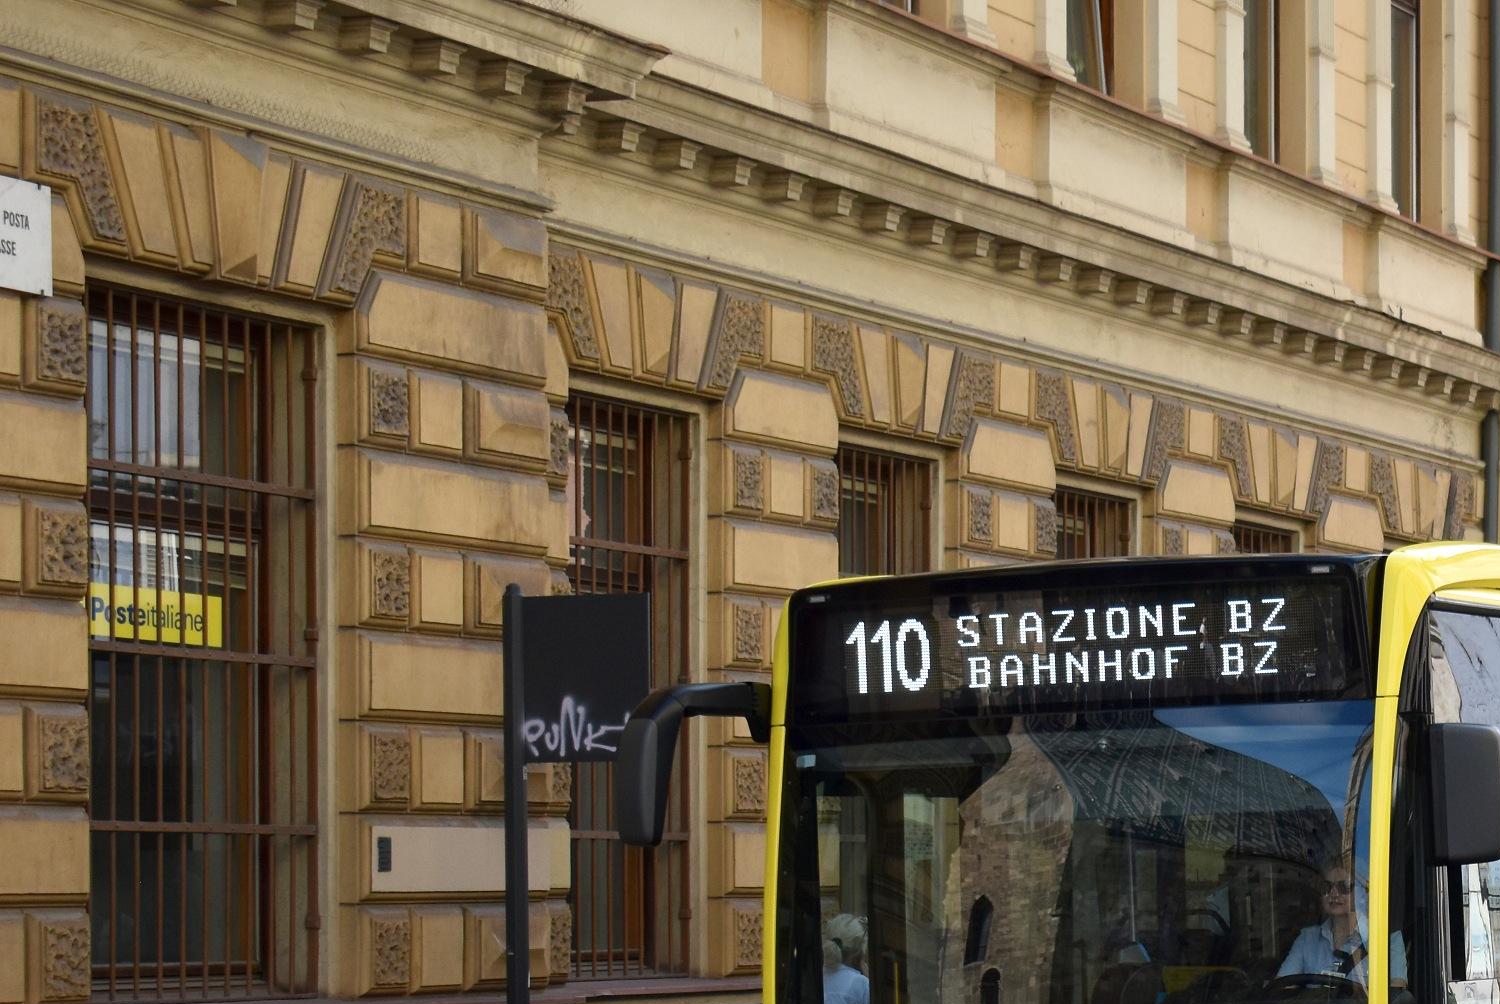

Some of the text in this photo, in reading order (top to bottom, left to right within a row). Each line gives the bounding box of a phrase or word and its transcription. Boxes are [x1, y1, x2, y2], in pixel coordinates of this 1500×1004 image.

[3, 210, 31, 231] POSTA
[956, 598, 1286, 647] STAZIONE BZ
[845, 618, 931, 694] 110
[967, 641, 1278, 689] BAHNHOF BZ
